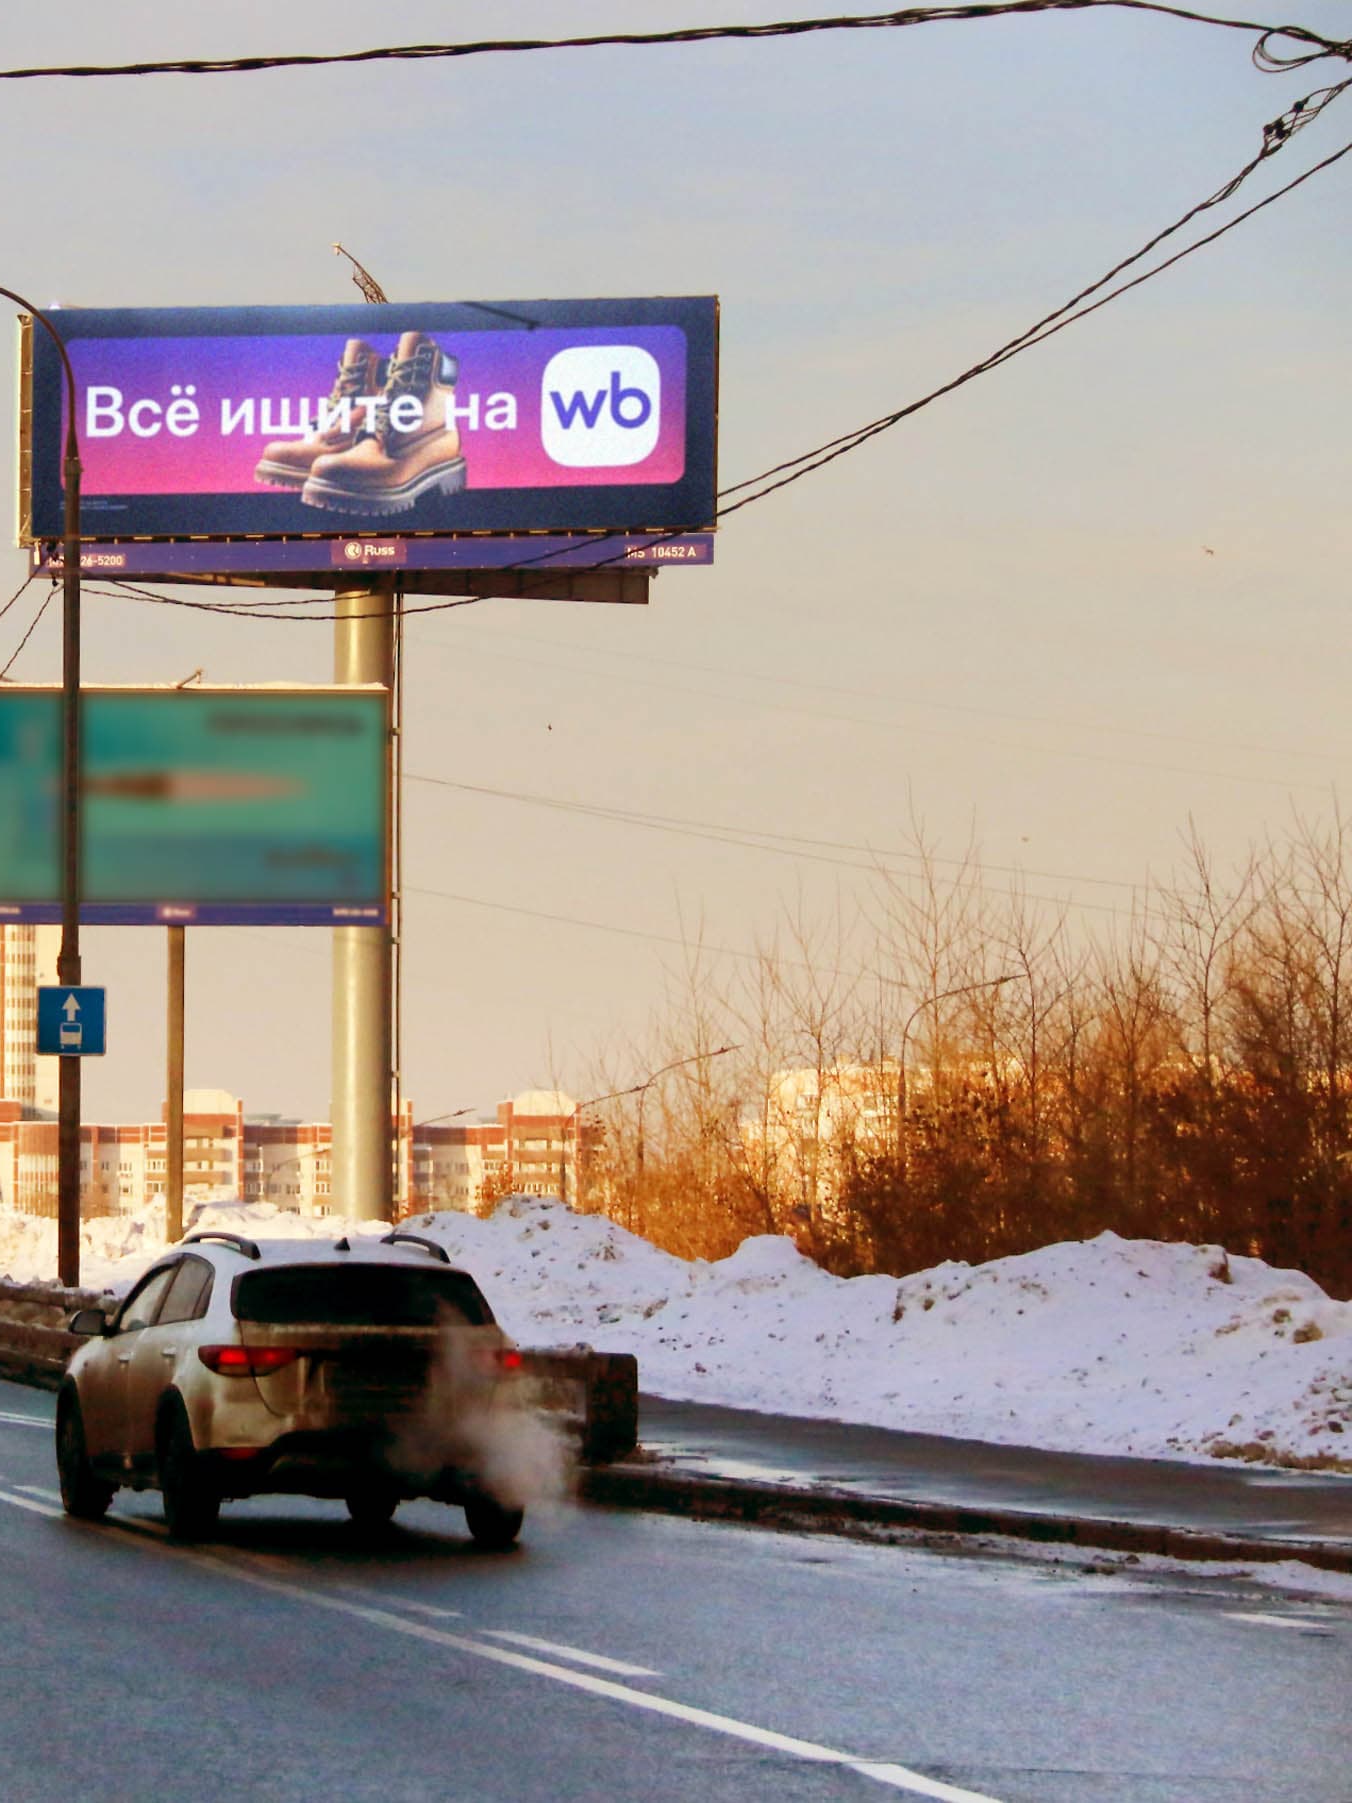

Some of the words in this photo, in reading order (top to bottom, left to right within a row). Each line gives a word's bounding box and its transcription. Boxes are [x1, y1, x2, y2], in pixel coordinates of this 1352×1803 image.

[86, 384, 200, 438] Всё
[220, 393, 425, 444] ищите
[444, 391, 518, 432] на
[550, 370, 652, 430] wb
[364, 544, 396, 556] Russ
[651, 546, 685, 558] 10452
